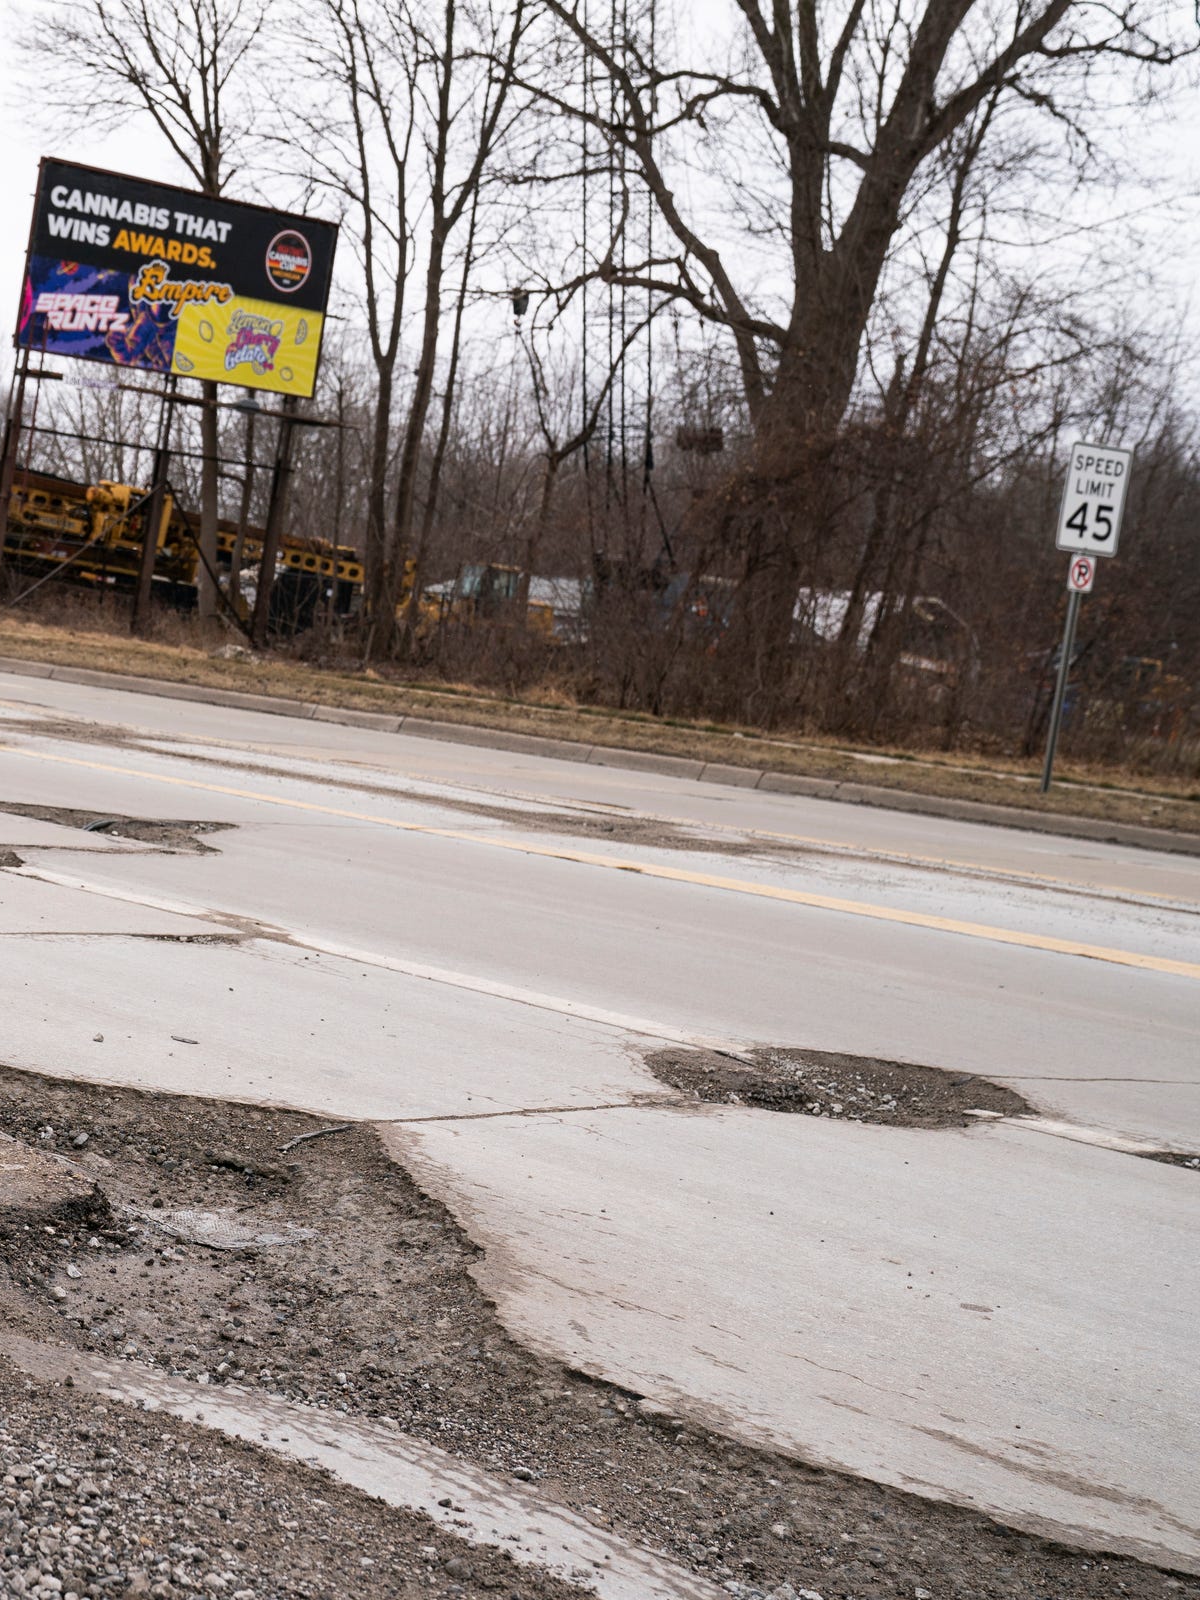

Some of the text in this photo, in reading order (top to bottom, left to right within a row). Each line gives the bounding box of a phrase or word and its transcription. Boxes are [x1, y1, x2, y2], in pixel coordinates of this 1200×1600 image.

[50, 185, 232, 243] CANNABIS THAT
[47, 213, 217, 269] WINS AWARDS.
[132, 262, 232, 317] Empire
[35, 292, 119, 312] SPACE
[43, 311, 130, 331] RUNTZ
[1075, 454, 1124, 477] SPEED
[1075, 478, 1115, 498] LIMIT
[1066, 502, 1114, 541] 45
[1077, 564, 1088, 582] P
